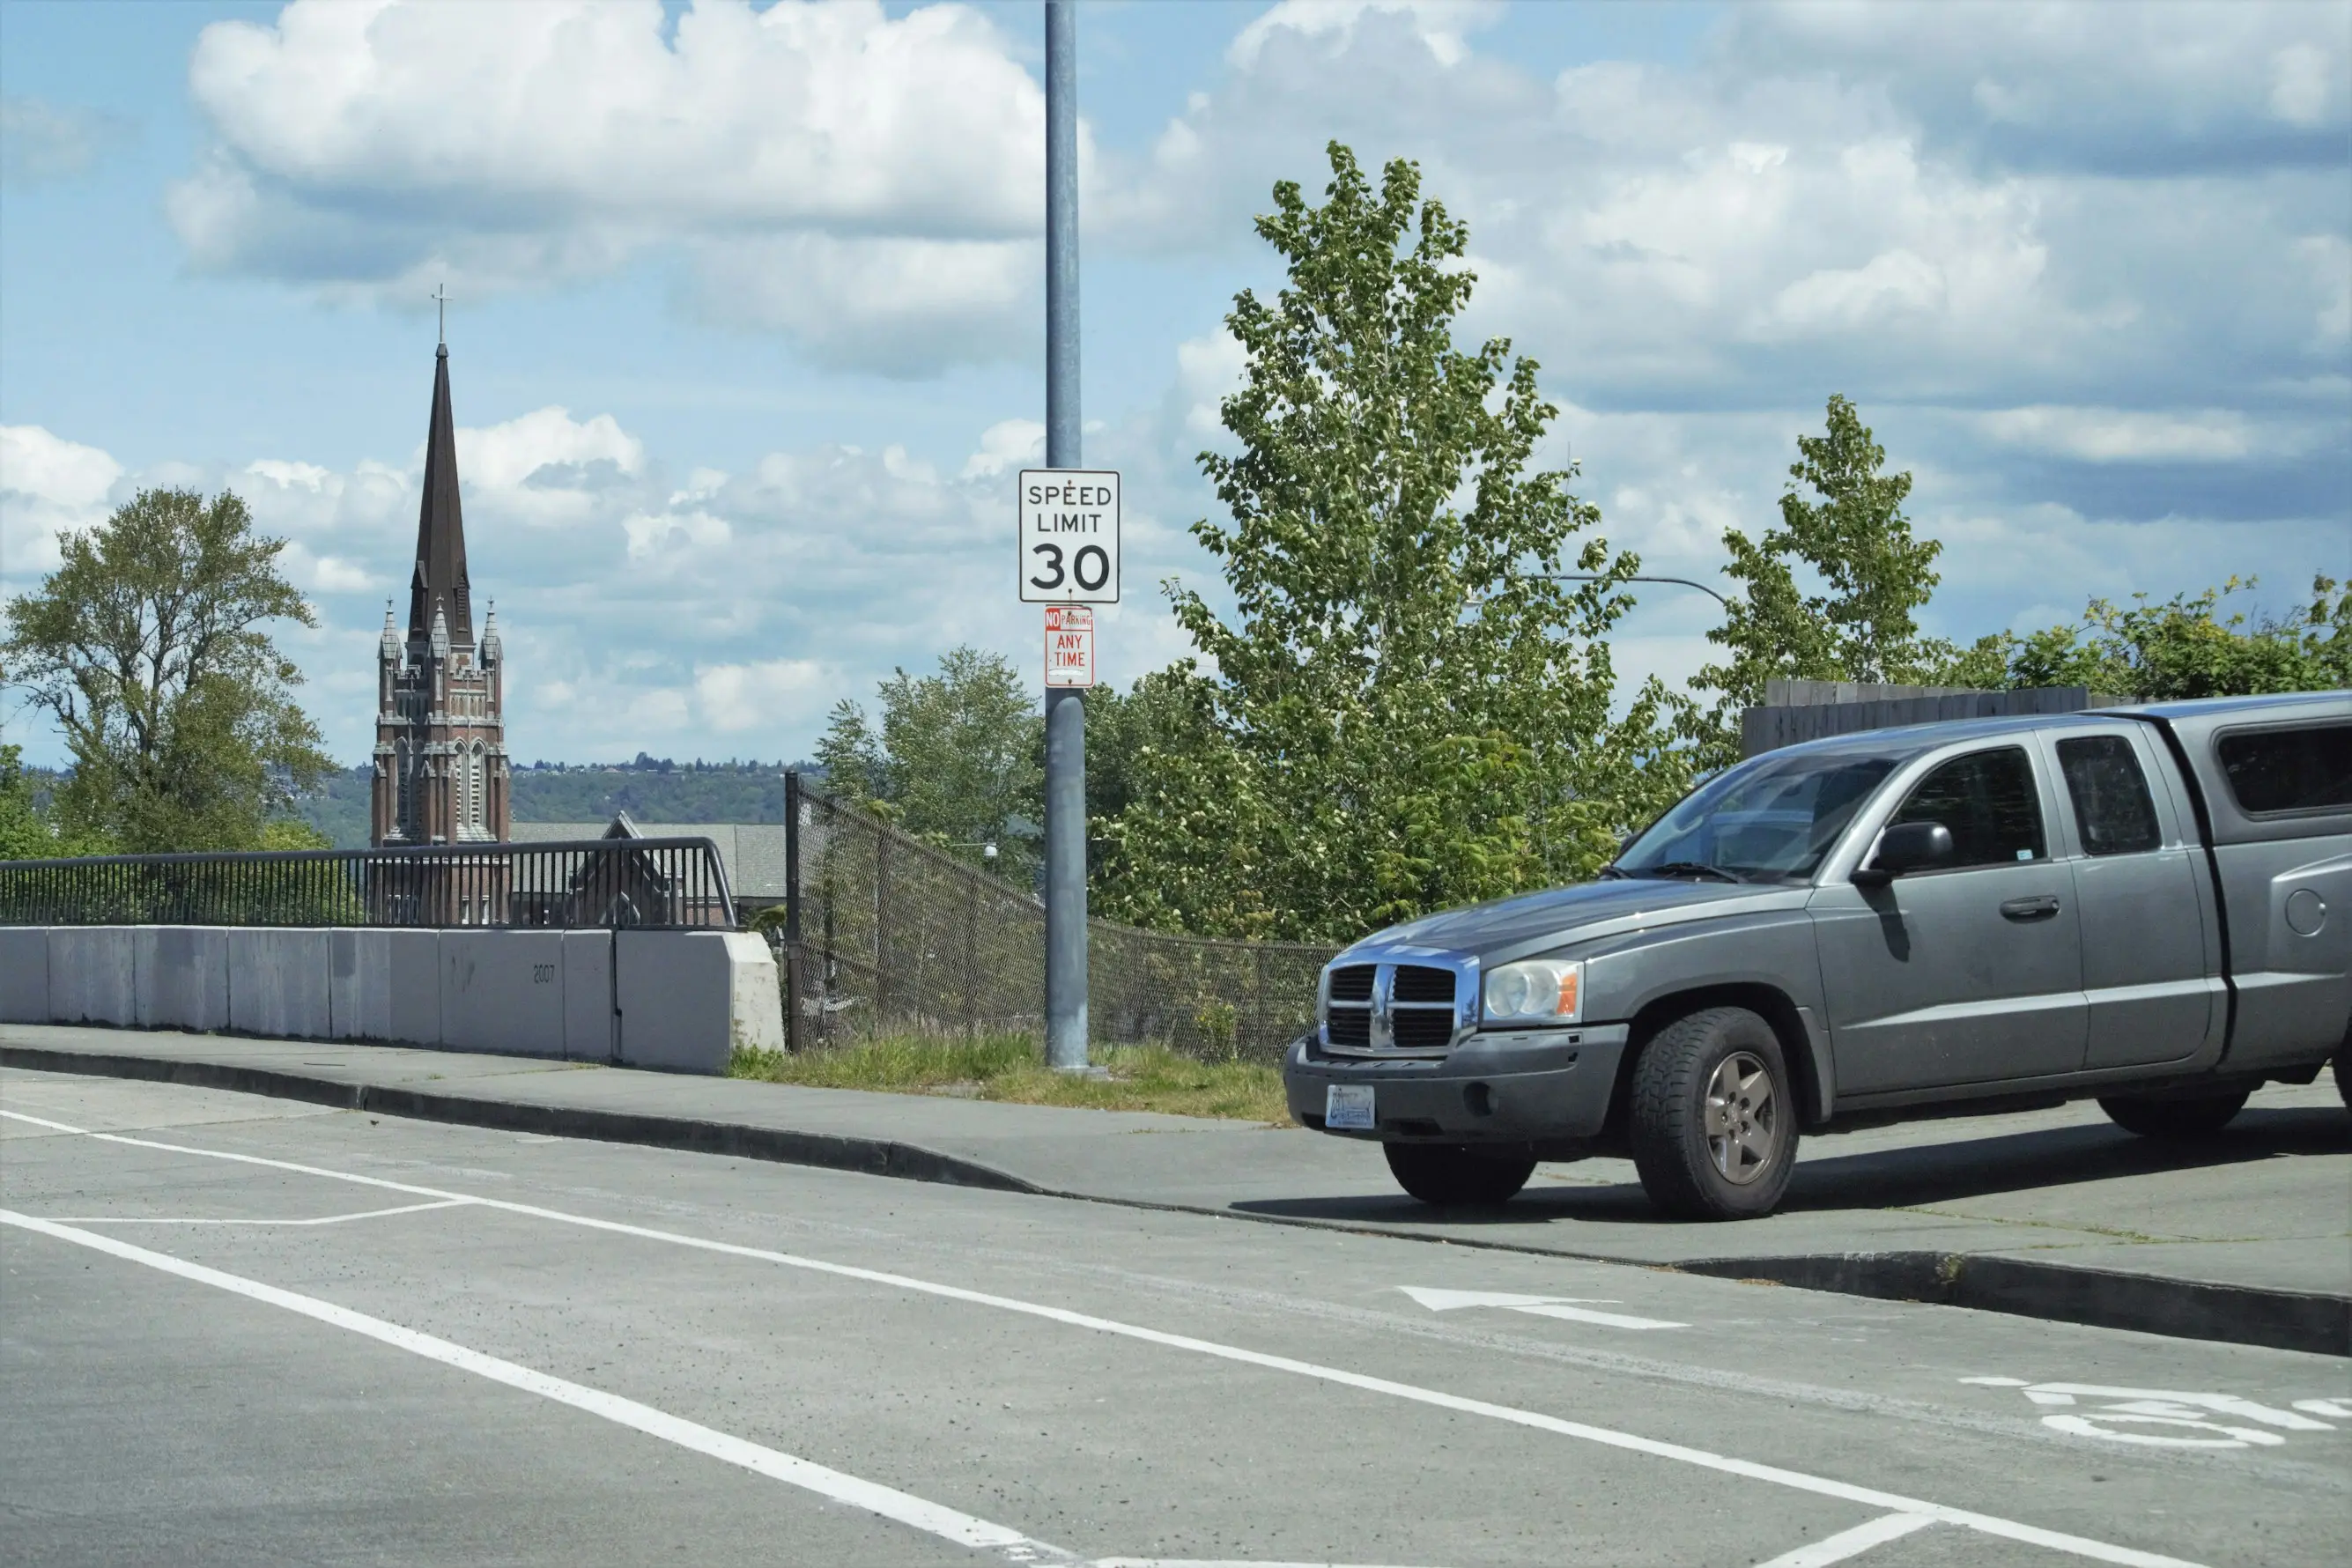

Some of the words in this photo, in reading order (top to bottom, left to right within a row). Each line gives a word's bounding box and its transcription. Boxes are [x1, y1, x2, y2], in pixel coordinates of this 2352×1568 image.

[1028, 485, 1112, 506] SPEED
[1038, 513, 1102, 533] LIMIT
[1030, 543, 1110, 592] 30
[1046, 611, 1060, 627] NO
[1061, 614, 1091, 625] PARKING
[1057, 634, 1083, 649] ANY
[1054, 652, 1085, 667] TIME
[533, 964, 555, 984] 2007
